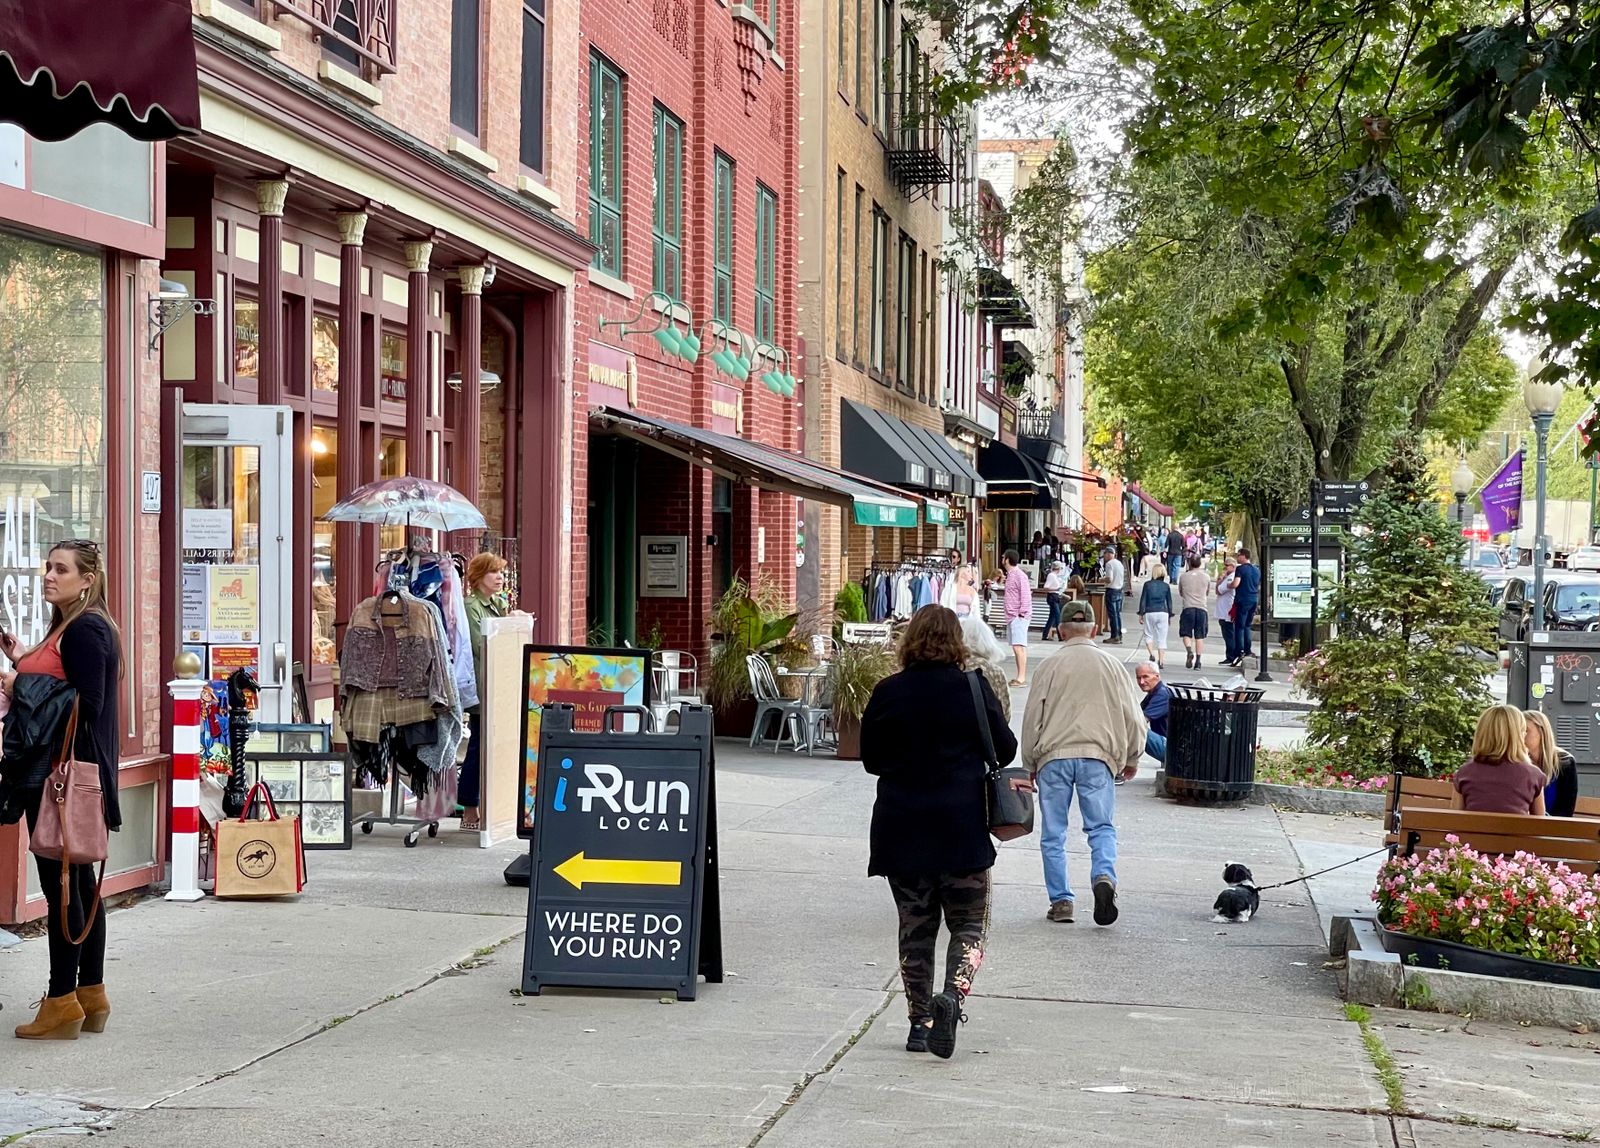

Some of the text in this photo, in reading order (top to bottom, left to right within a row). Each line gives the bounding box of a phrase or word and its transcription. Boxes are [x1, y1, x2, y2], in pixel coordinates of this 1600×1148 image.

[144, 476, 159, 500] 427
[3, 496, 41, 568] ALL
[3, 574, 50, 648] SEA
[600, 816, 688, 832] LOCAL
[545, 911, 683, 935] WHERE DO
[549, 935, 681, 961] YOU RUN?
